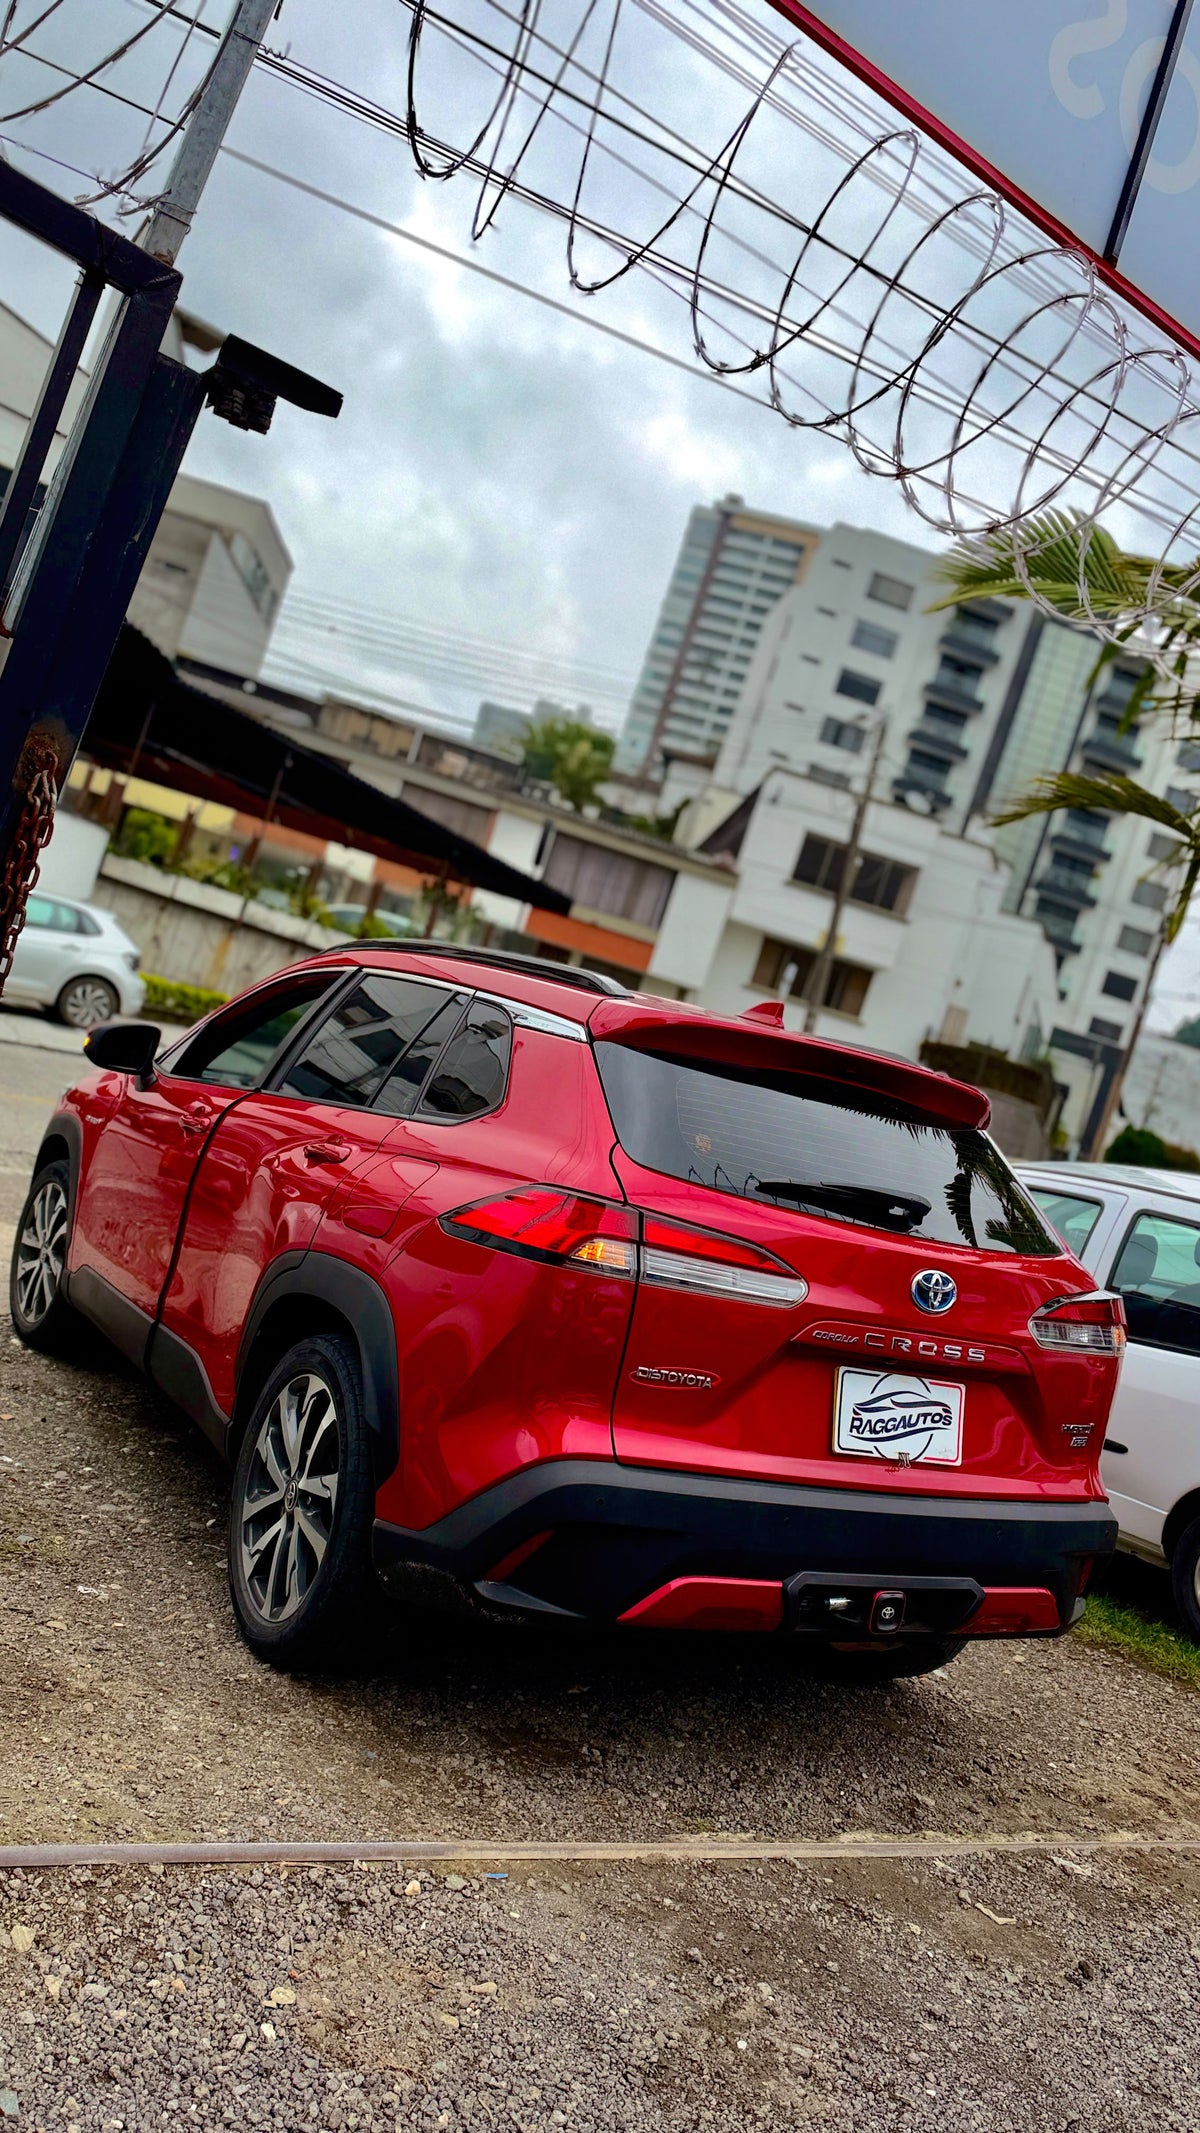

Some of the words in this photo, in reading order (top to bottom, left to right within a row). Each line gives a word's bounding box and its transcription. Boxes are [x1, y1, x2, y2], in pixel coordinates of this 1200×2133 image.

[812, 1330, 859, 1343] COROLLA
[864, 1332, 986, 1363] CROSS
[636, 1366, 712, 1388] DISTOYOTA
[849, 1412, 953, 1435] RAGGAUTOS
